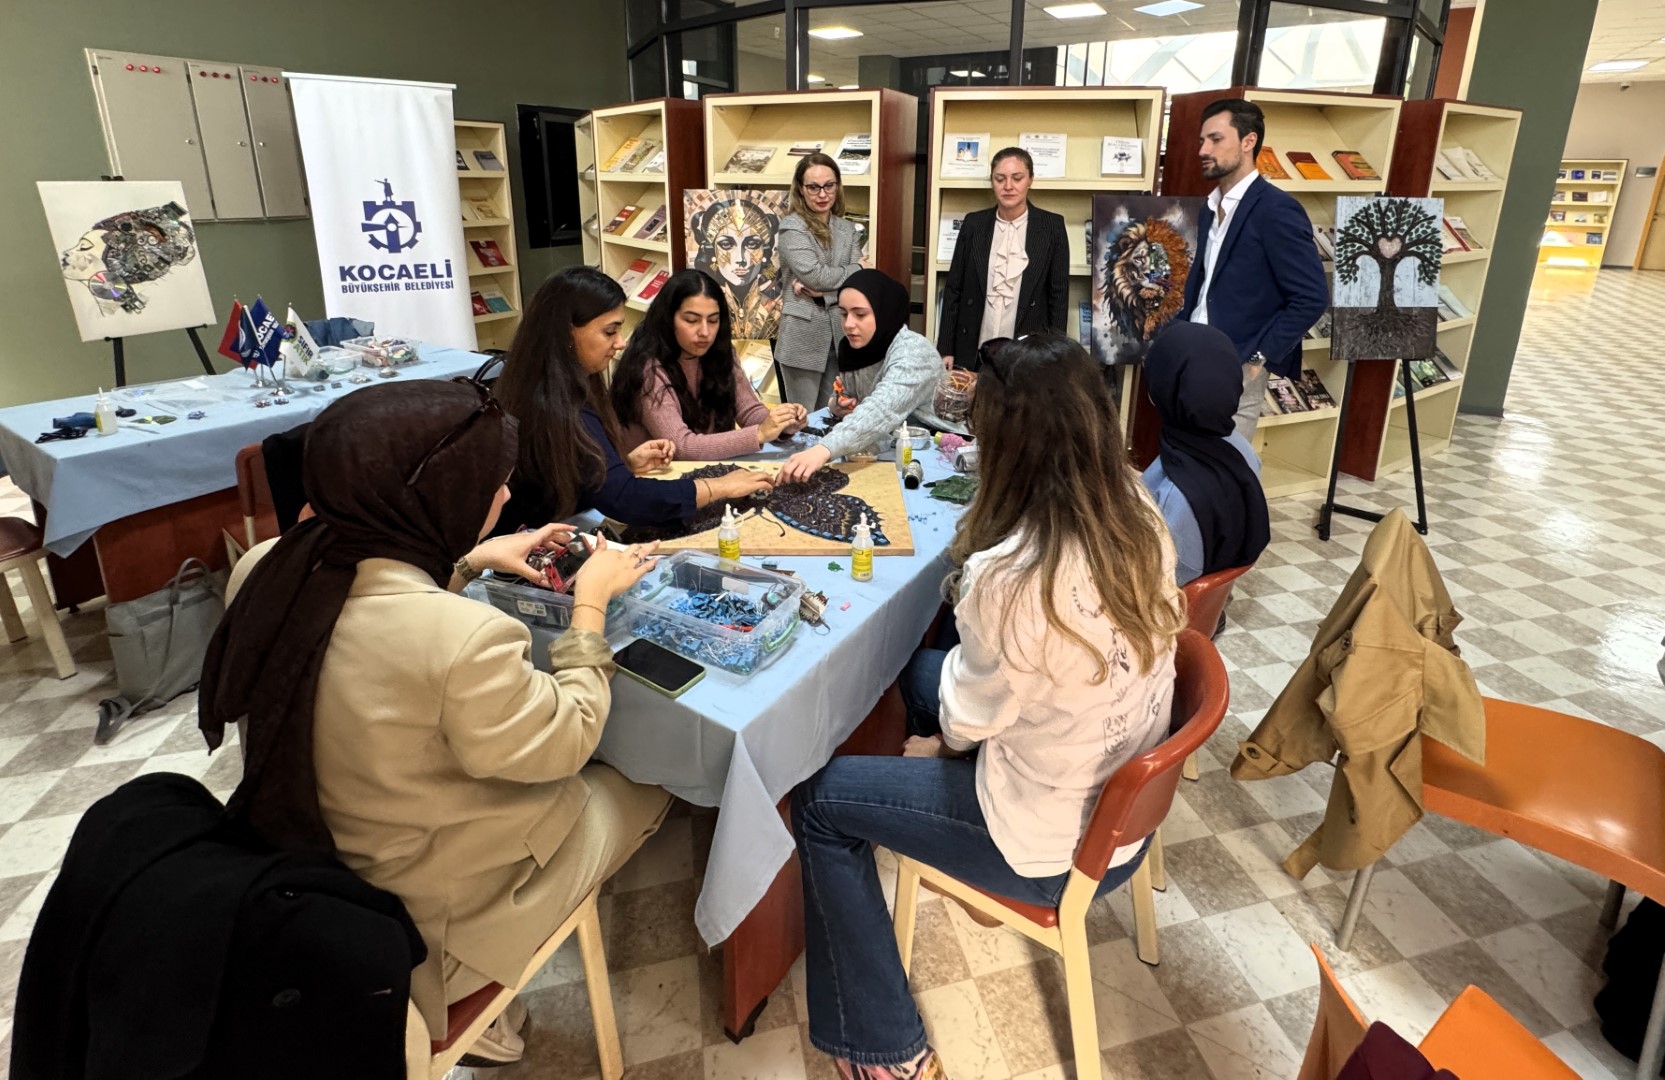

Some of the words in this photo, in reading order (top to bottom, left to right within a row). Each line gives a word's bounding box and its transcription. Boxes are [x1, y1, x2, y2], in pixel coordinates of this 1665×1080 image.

[339, 259, 453, 282] KOCAELİ
[341, 281, 401, 293] BÜYÜKŞEHİR
[405, 280, 454, 291] BELEDİYESİ
[257, 312, 275, 341] OCAE
[293, 344, 310, 366] ATIK
[298, 335, 314, 359] SIFIR
